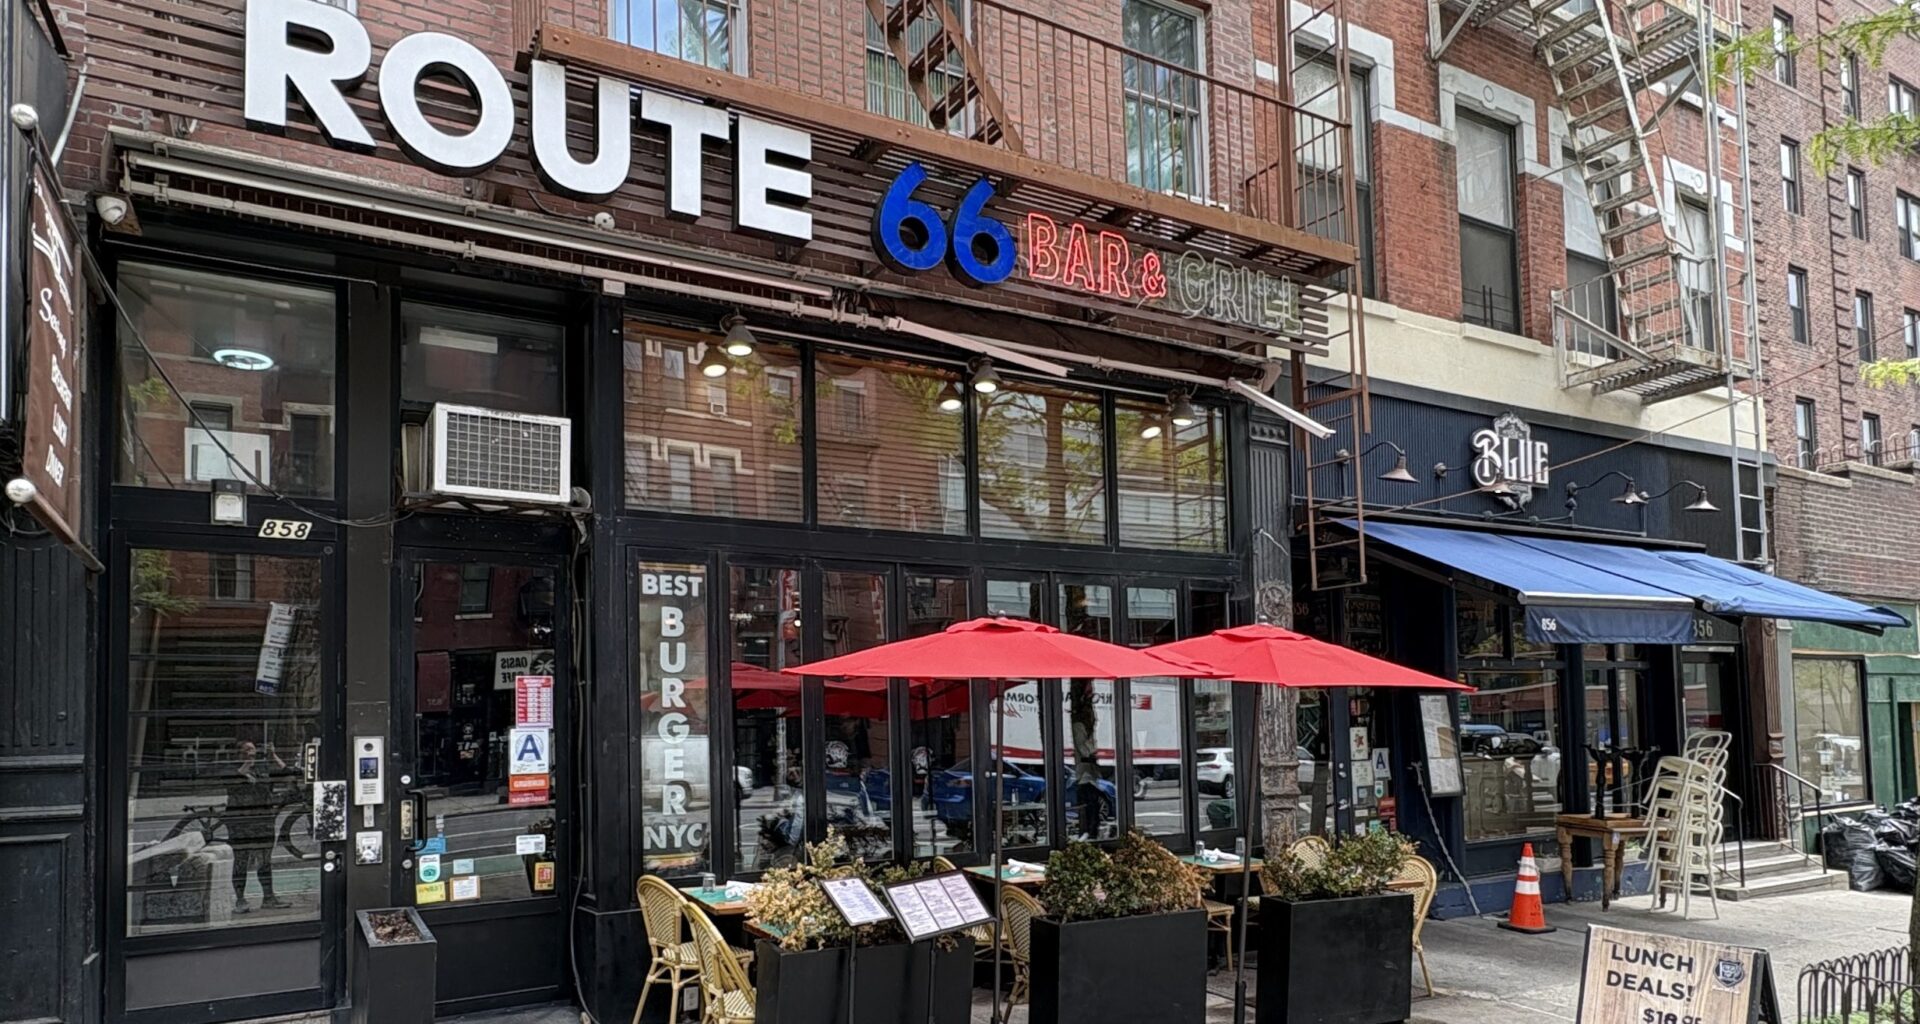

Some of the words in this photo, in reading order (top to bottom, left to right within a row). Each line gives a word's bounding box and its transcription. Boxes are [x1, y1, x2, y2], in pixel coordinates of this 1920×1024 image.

[244, 0, 812, 240] ROUTE
[874, 161, 1016, 286] 66
[1028, 212, 1131, 298] BAR
[1142, 252, 1167, 298] &
[1178, 250, 1303, 335] GRILL
[1473, 429, 1549, 486] BLUE
[263, 521, 308, 538] 858
[642, 574, 703, 597] BEST
[1541, 618, 1557, 631] 856
[658, 606, 690, 816] BURGER
[517, 734, 543, 761] A
[1375, 751, 1386, 770] A
[307, 747, 316, 780] PULL
[643, 822, 703, 850] NYC
[1611, 944, 1694, 974] LUNCH
[1606, 970, 1694, 1001] DEALS!
